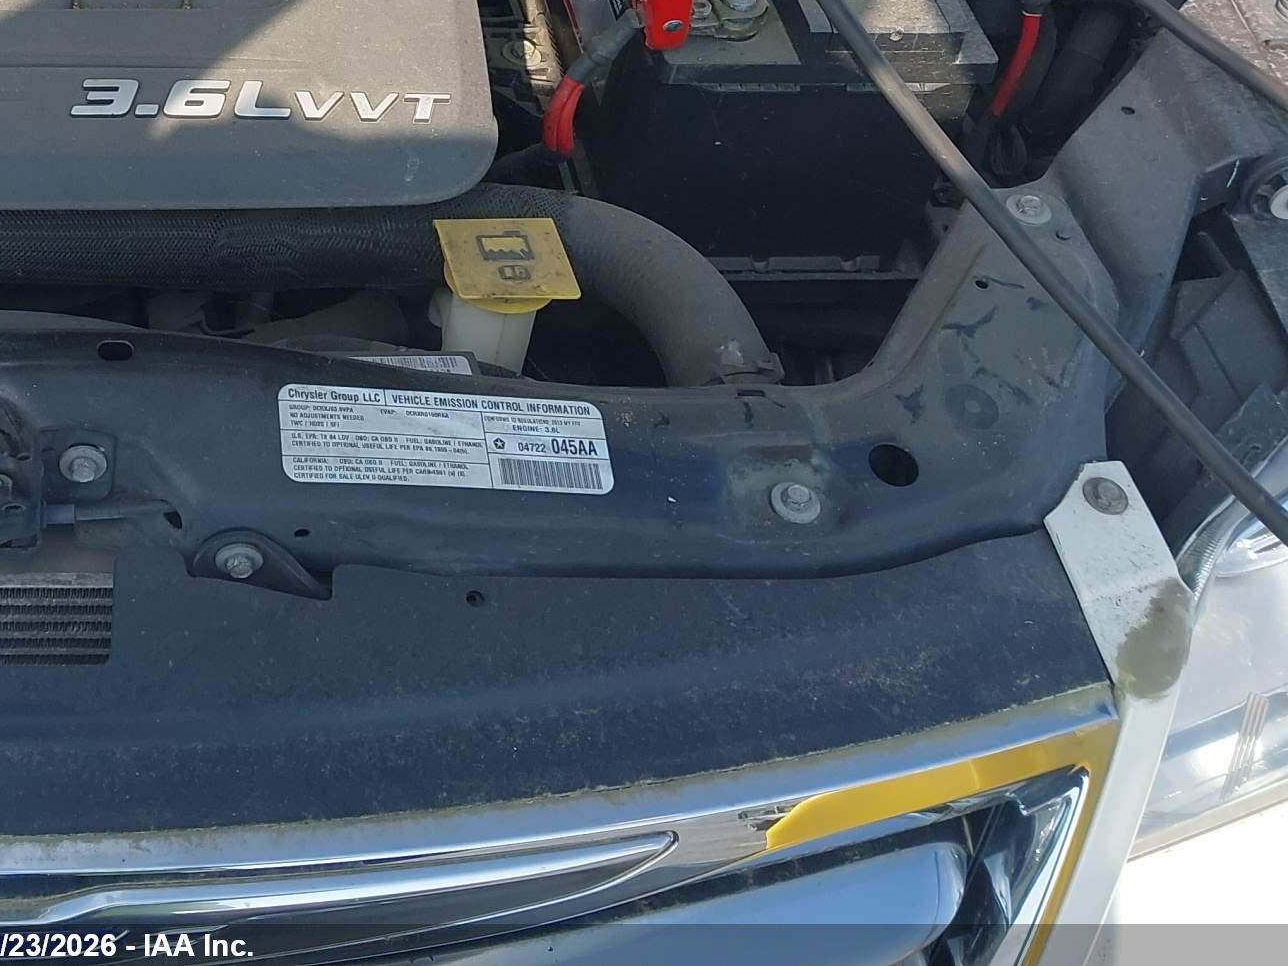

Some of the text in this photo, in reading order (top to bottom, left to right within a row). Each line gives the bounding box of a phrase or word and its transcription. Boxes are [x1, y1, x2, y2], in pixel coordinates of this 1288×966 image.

[288, 388, 381, 403] Chrysler Group LLC
[392, 394, 591, 416] VEHICLE EMISSION CONTROL INFORMATION
[517, 438, 599, 456] 04722 045AA
